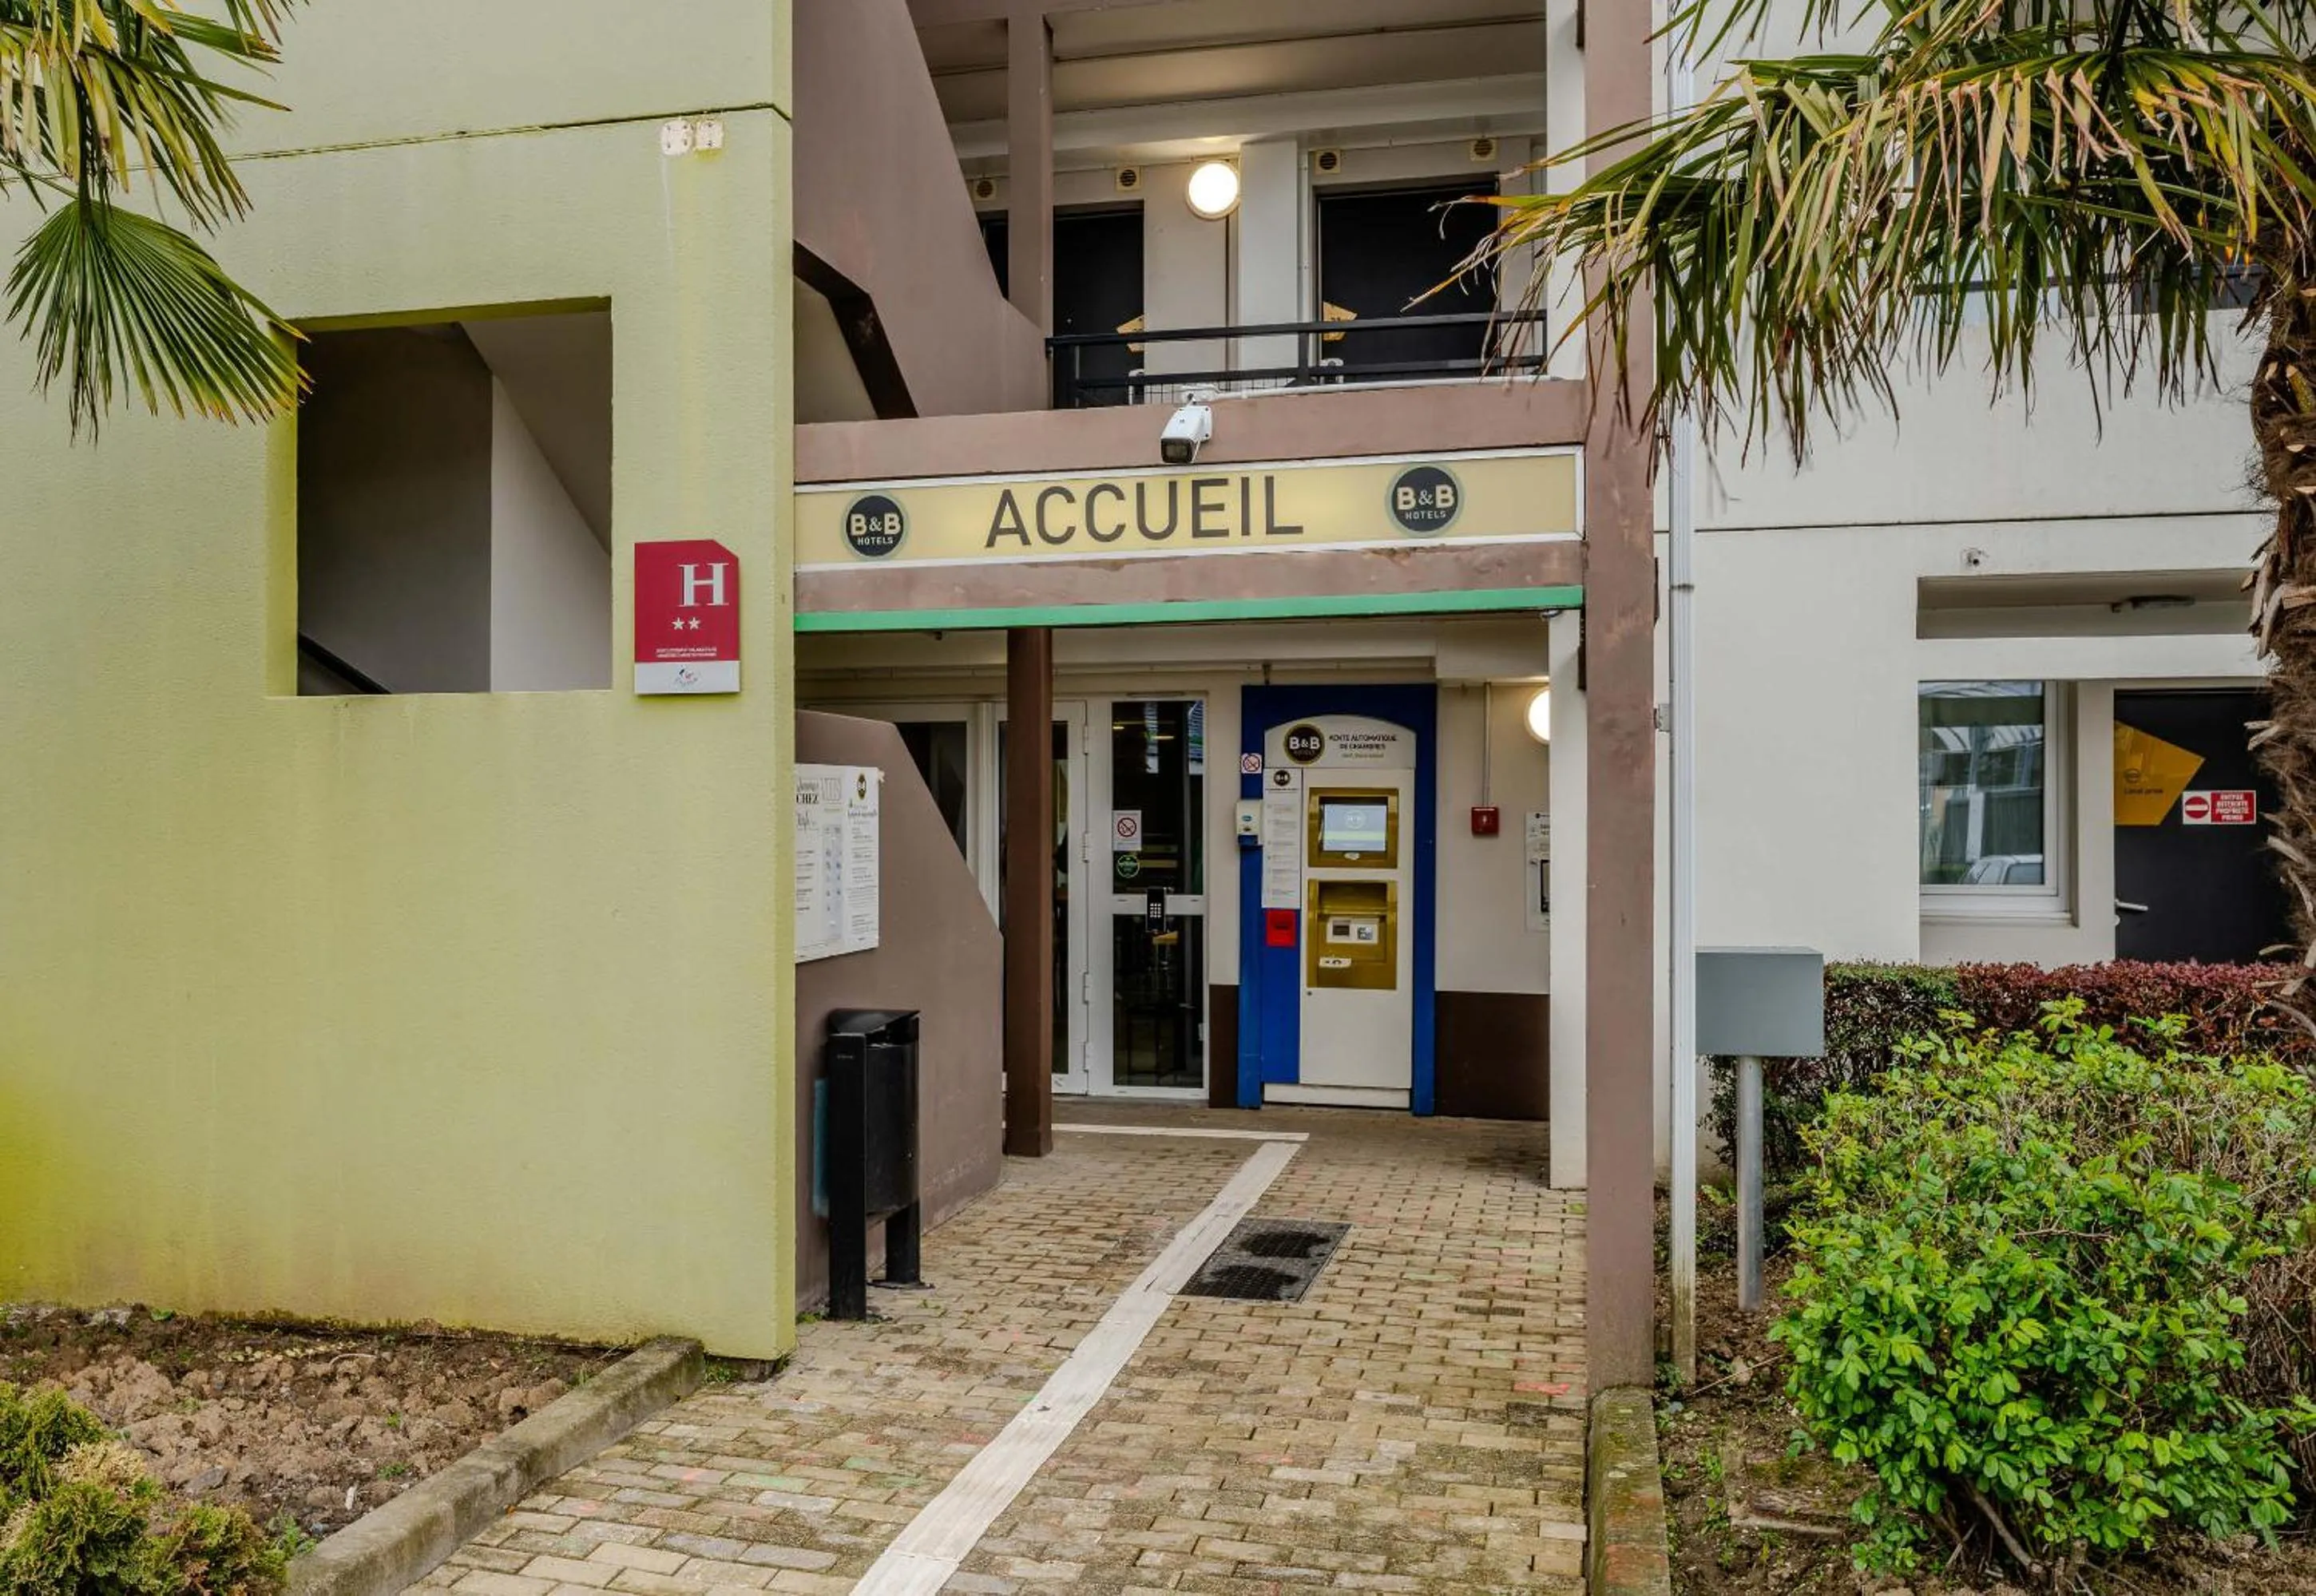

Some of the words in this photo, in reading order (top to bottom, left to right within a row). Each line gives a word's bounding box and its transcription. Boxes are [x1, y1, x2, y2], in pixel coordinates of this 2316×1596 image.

[1397, 484, 1454, 510] B&B
[985, 476, 1303, 548] ACCUEIL
[1406, 510, 1446, 520] HOTELS
[851, 513, 901, 536] B&B
[857, 537, 894, 546] HOTELS
[677, 562, 730, 607] H
[1289, 736, 1320, 749] B&B
